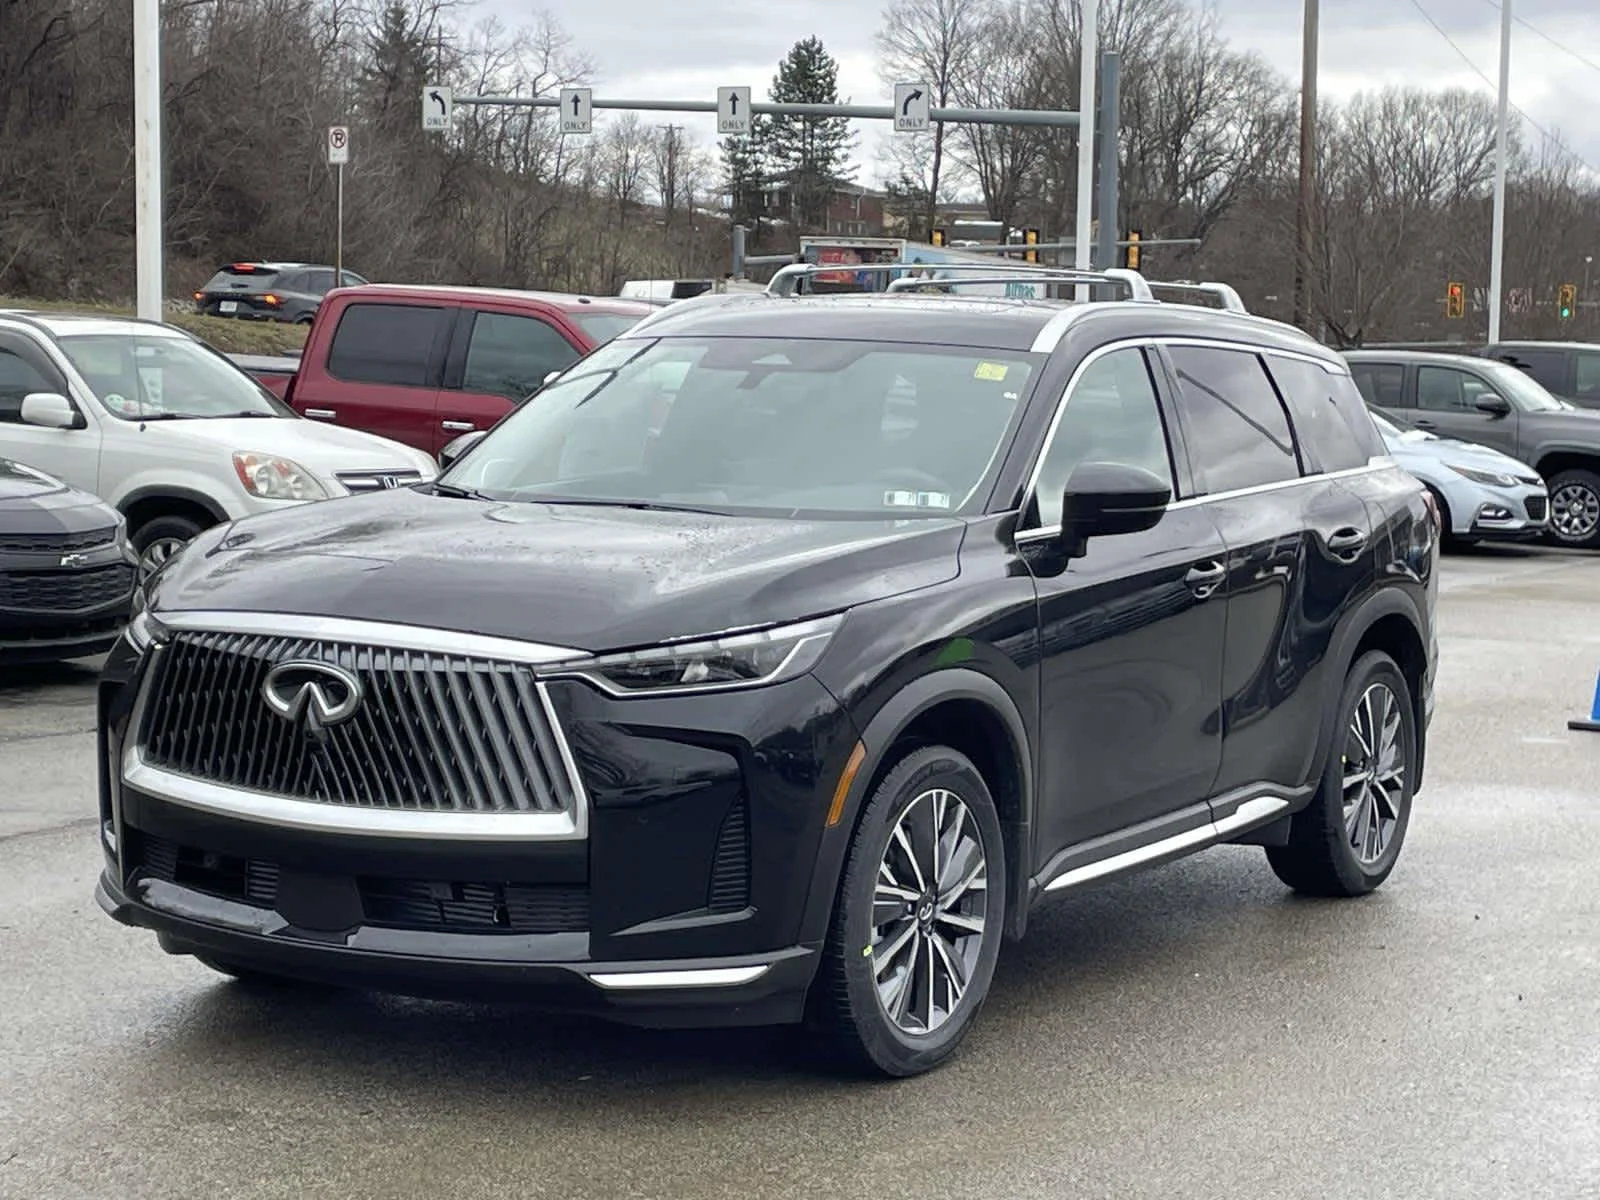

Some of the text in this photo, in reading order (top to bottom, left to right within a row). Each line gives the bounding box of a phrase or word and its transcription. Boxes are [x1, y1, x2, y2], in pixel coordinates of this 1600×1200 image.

[564, 121, 588, 129] ONLY
[722, 120, 744, 129] ONLY
[899, 118, 924, 127] ONLY
